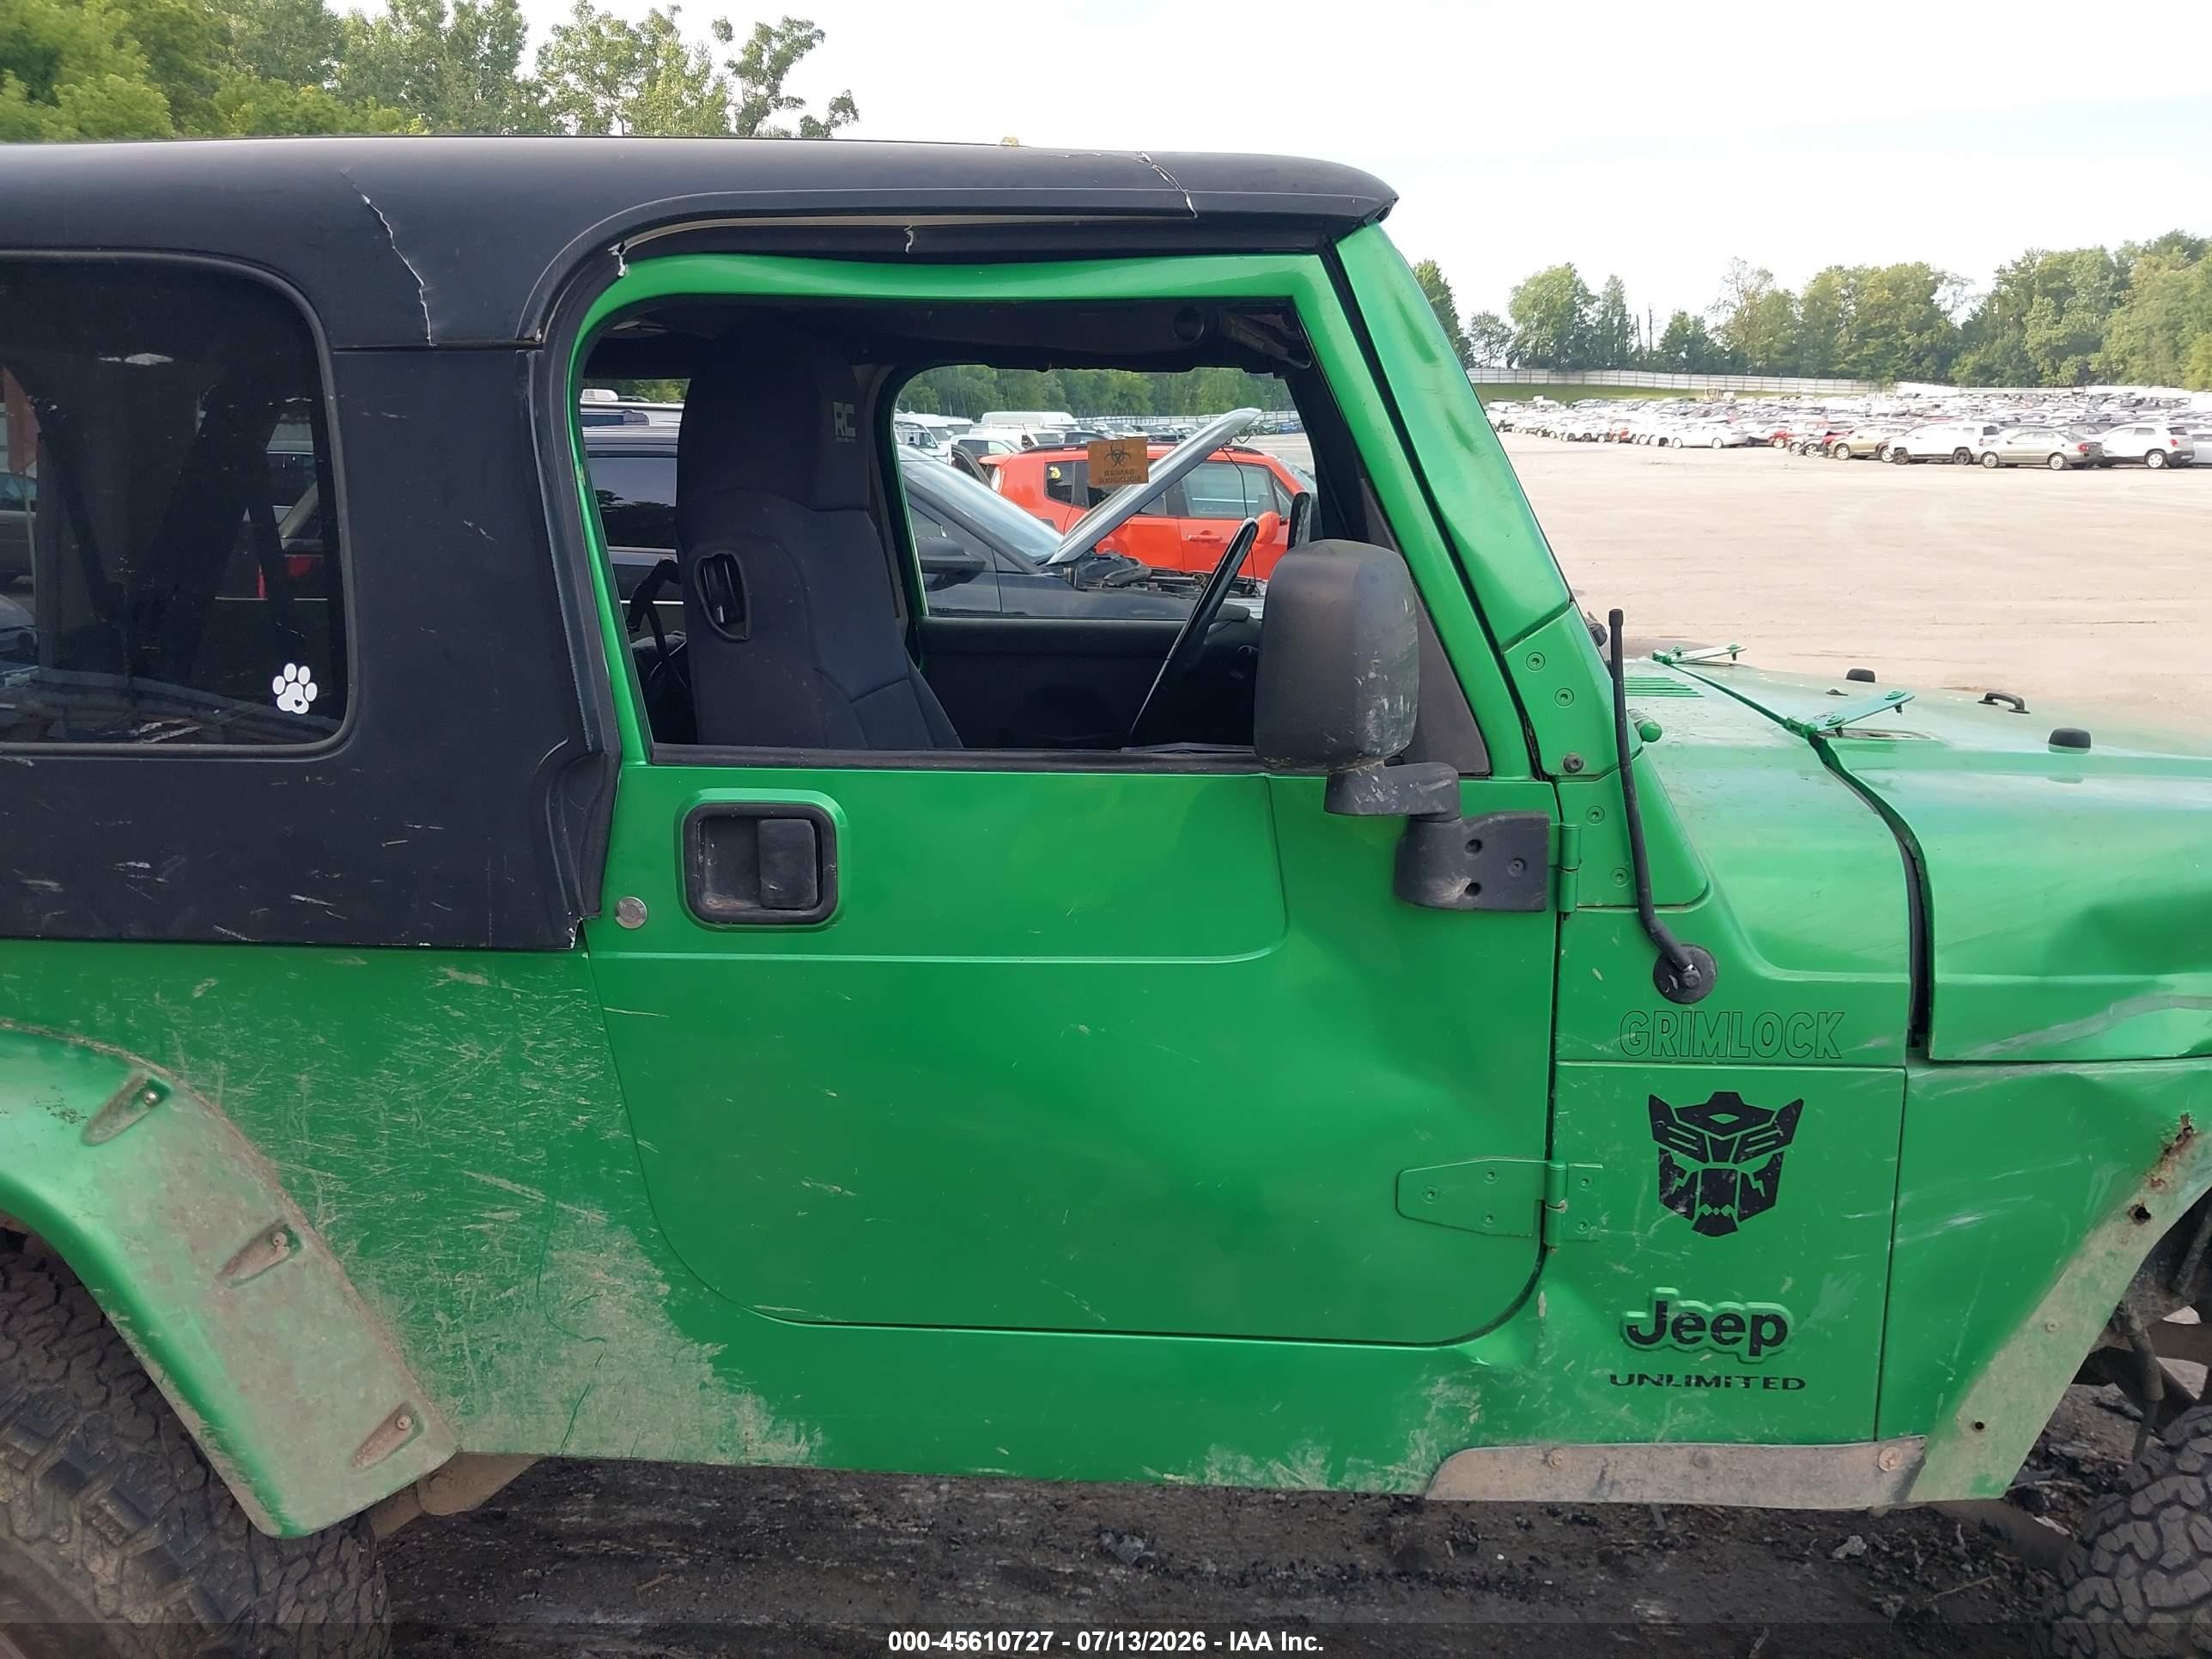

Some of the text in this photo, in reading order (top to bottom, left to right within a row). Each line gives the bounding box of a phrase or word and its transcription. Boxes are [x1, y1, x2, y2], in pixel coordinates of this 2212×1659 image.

[1620, 1010, 1845, 1059] GRIMLOCK
[1626, 1300, 1789, 1357] Jeep
[1609, 1373, 1807, 1390] UNLIMITED
